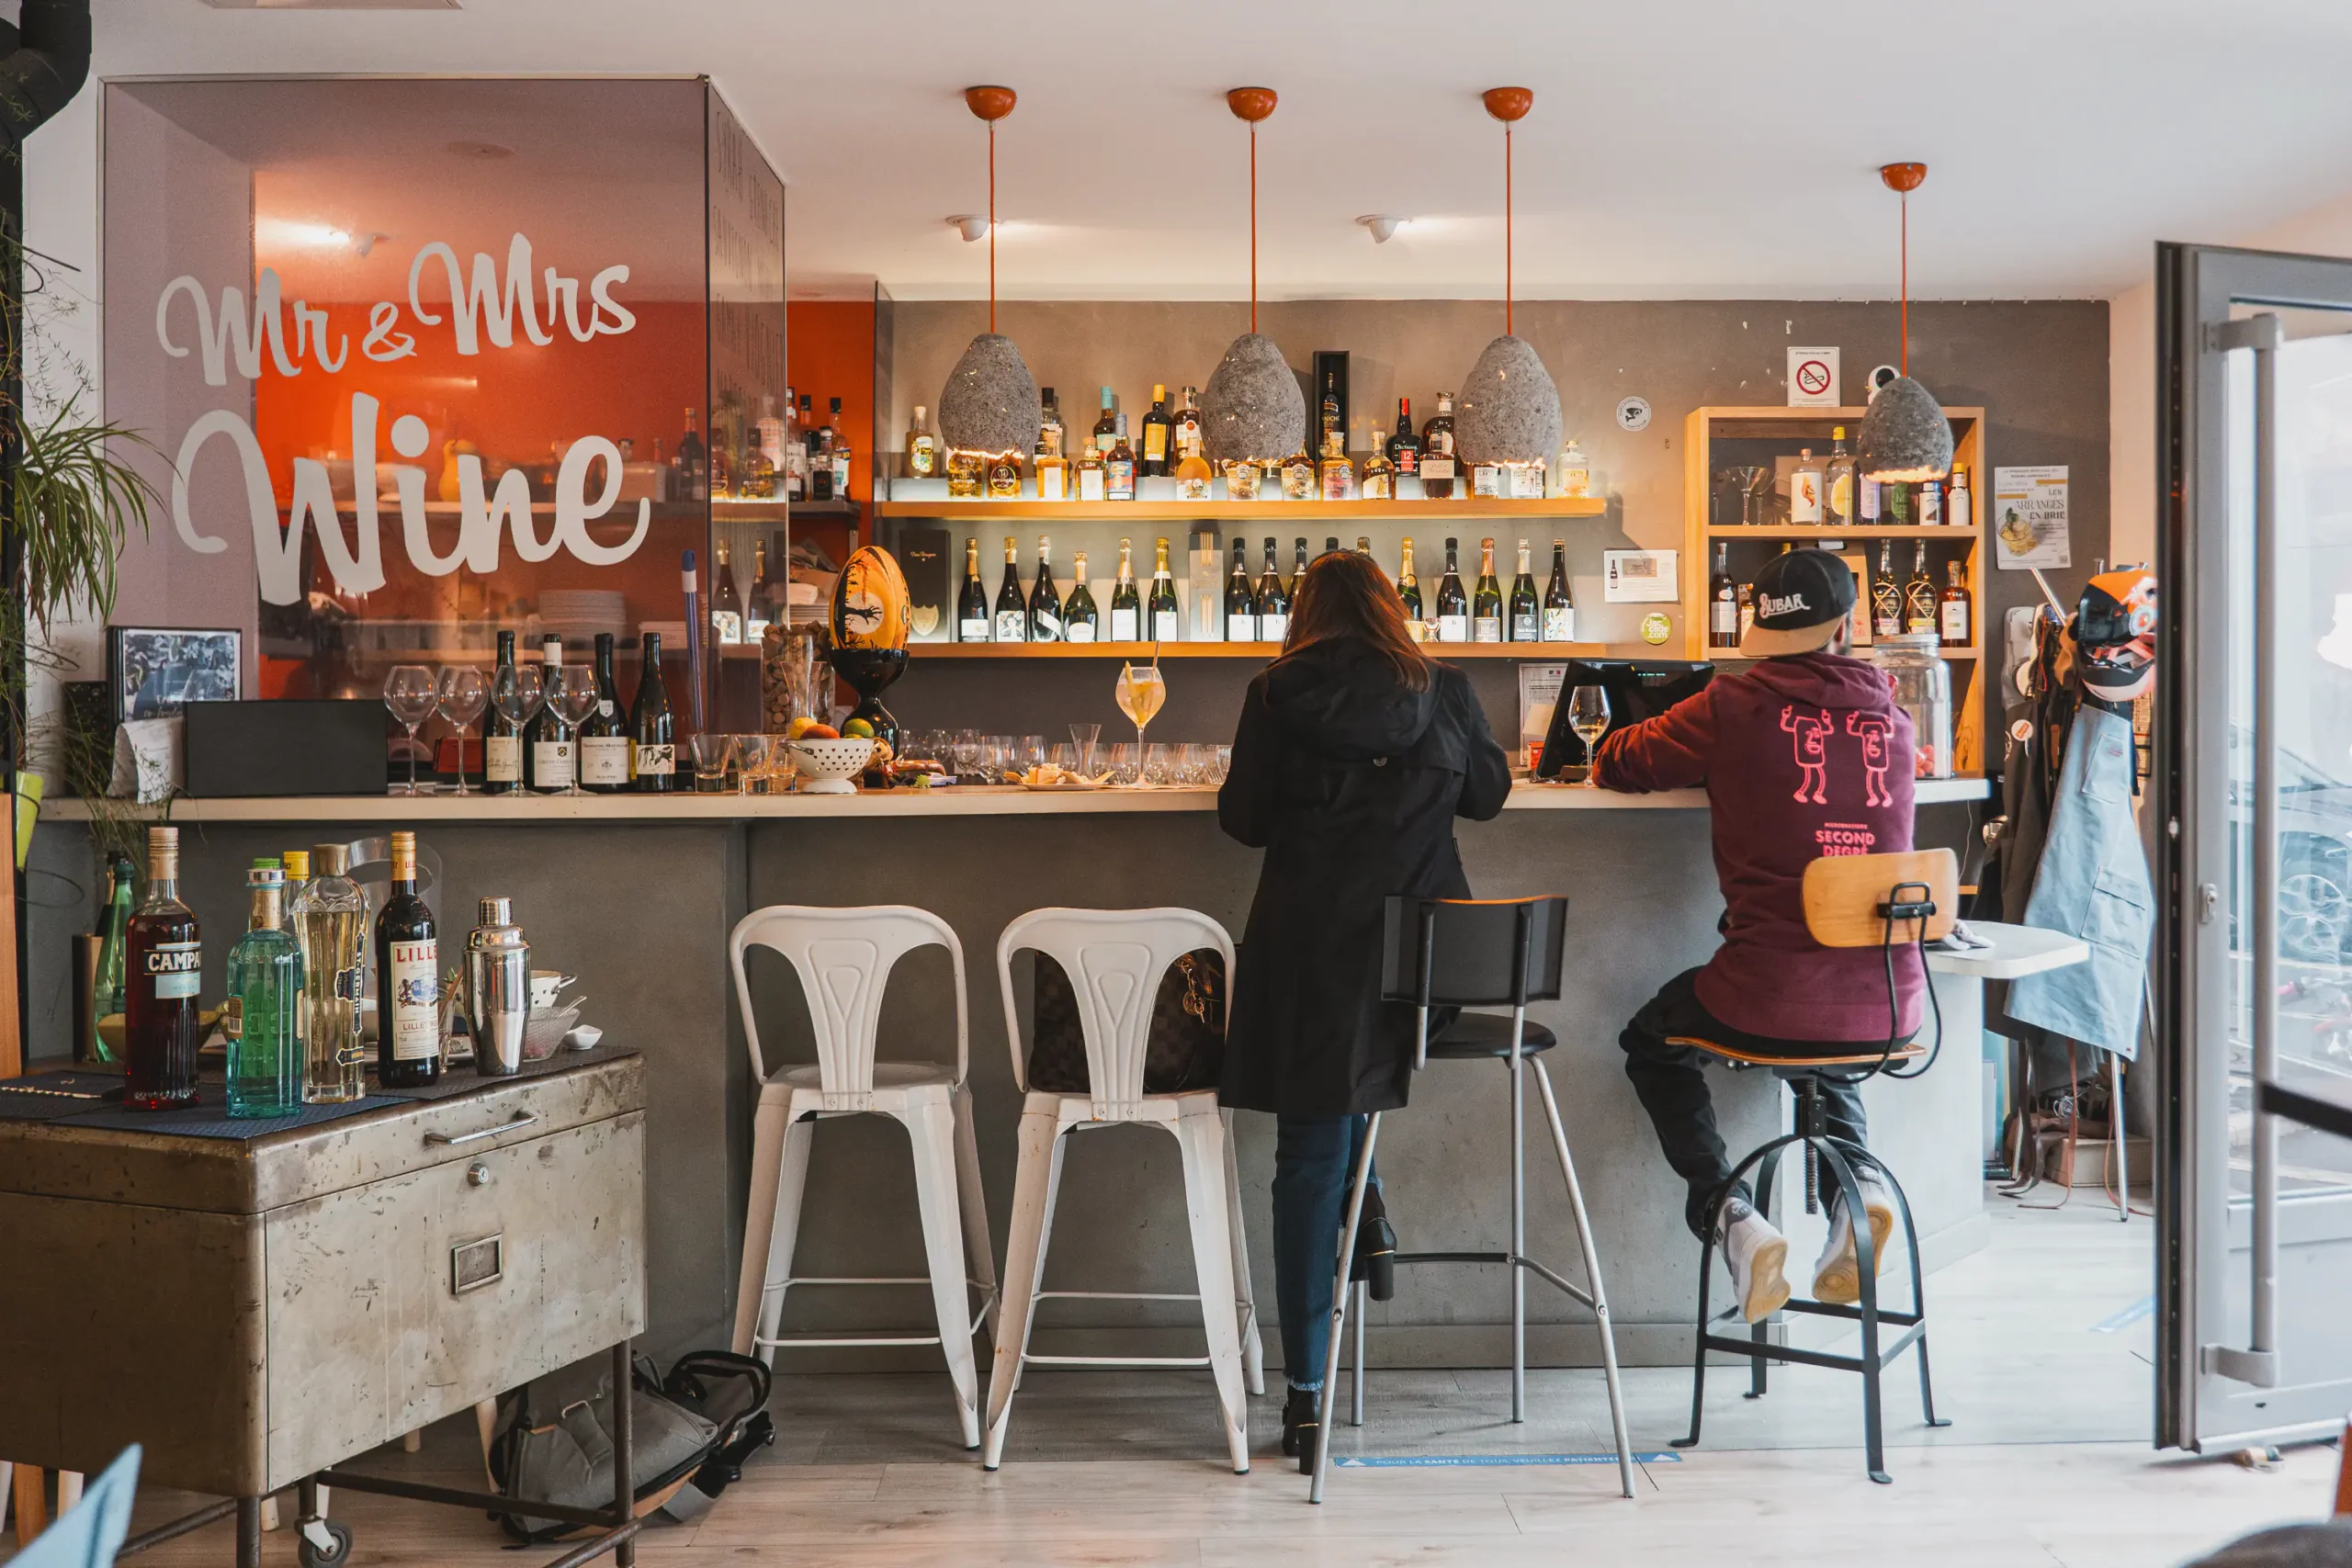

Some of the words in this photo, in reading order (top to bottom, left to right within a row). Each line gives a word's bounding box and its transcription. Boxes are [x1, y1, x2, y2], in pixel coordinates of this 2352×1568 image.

[156, 267, 347, 386] Mr
[362, 301, 417, 362] &
[408, 231, 636, 355] Mrs
[1403, 451, 1411, 460] 12
[172, 391, 650, 606] Wine
[1815, 829, 1876, 846] SECOND
[148, 950, 201, 972] CAMPA
